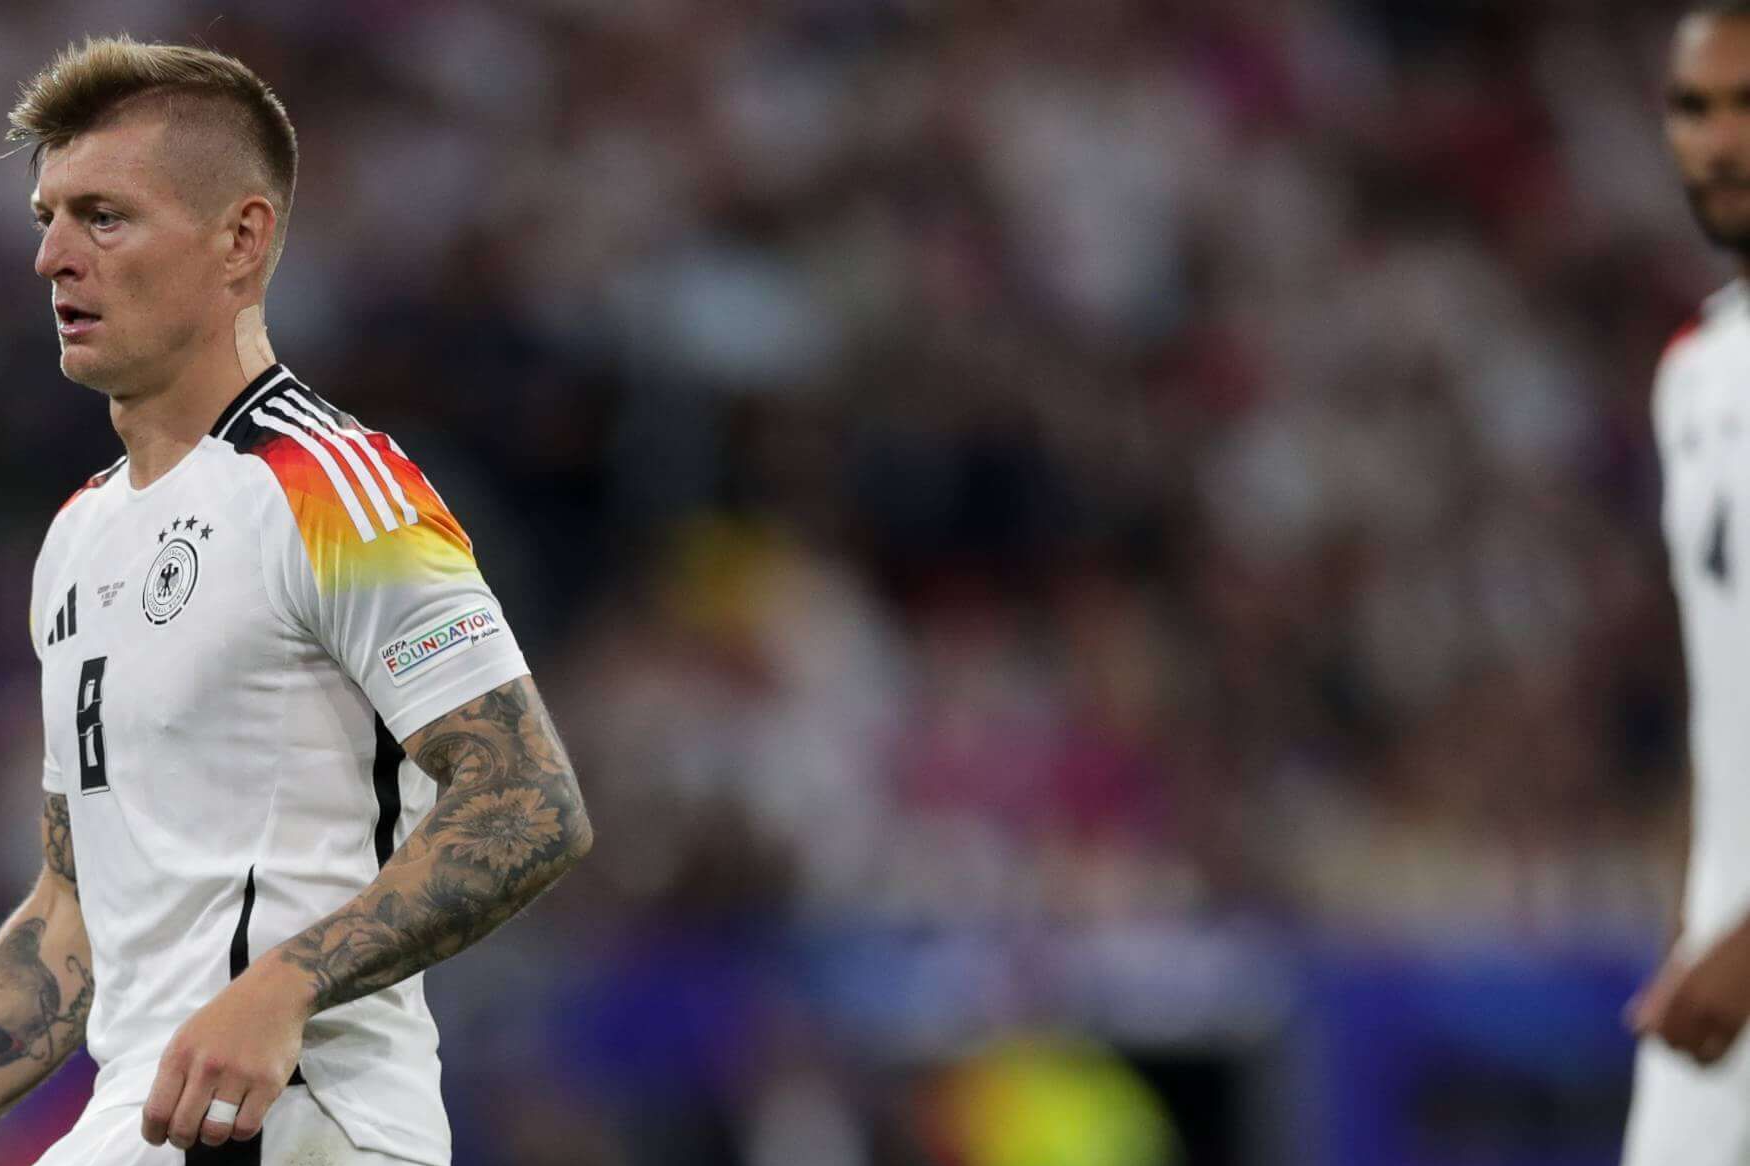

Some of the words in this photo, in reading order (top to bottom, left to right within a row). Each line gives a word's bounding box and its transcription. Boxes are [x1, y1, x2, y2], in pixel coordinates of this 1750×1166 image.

[382, 640, 408, 659] UEFA
[386, 611, 495, 673] FOUNDATION
[76, 656, 110, 796] 8
